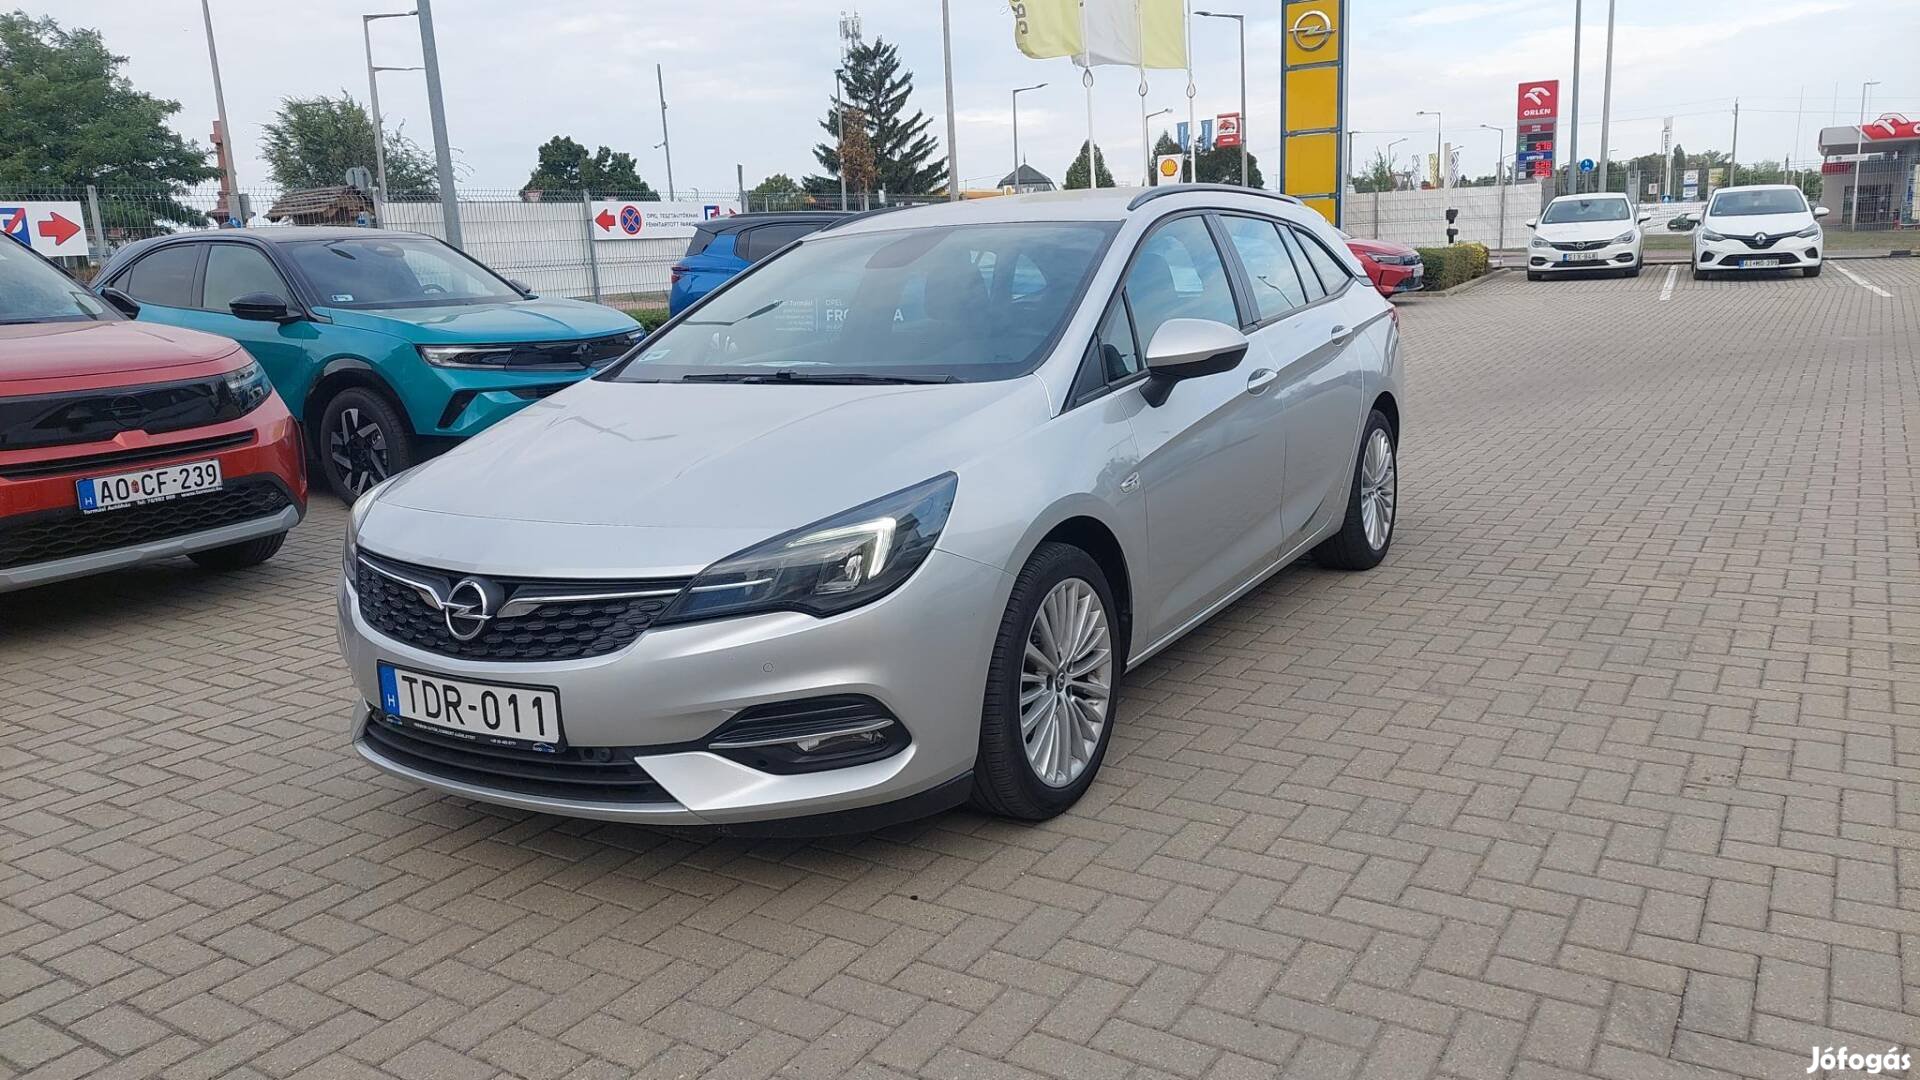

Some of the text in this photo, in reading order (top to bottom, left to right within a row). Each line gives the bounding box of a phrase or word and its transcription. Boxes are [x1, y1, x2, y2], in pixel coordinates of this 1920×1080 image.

[1523, 108, 1551, 116] ORLEN
[84, 496, 94, 506] H
[387, 694, 396, 708] H
[401, 674, 545, 736] TDR-011
